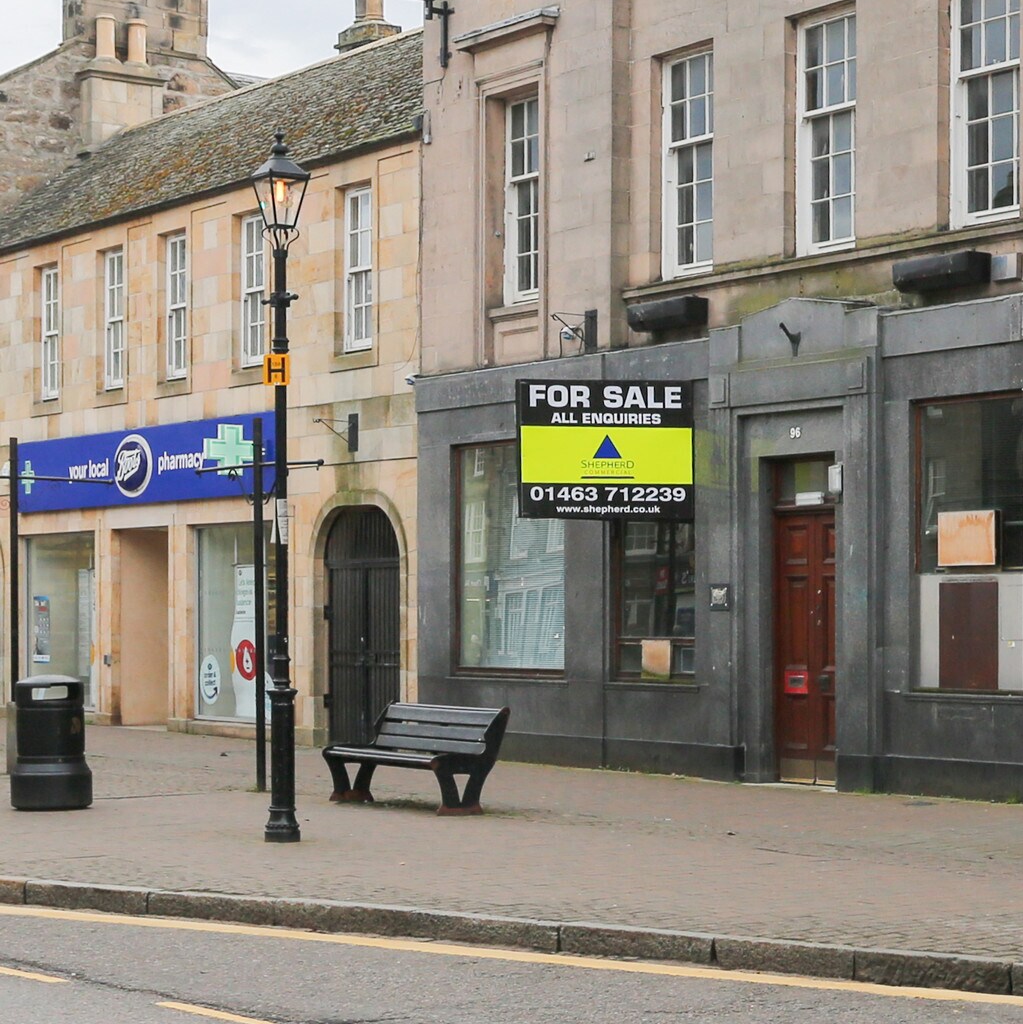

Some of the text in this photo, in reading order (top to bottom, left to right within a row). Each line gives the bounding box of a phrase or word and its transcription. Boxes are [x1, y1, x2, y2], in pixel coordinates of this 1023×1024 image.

[267, 357, 285, 383] H
[529, 384, 682, 409] FOR SALE
[551, 412, 661, 425] ALL ENQUIRIES
[789, 426, 801, 439] 96
[68, 448, 204, 484] your local Boots pharmacy
[581, 460, 635, 470] SHEPHERD
[530, 486, 686, 502] 01463 712239
[556, 505, 661, 515] www.shepherd.co.uk
